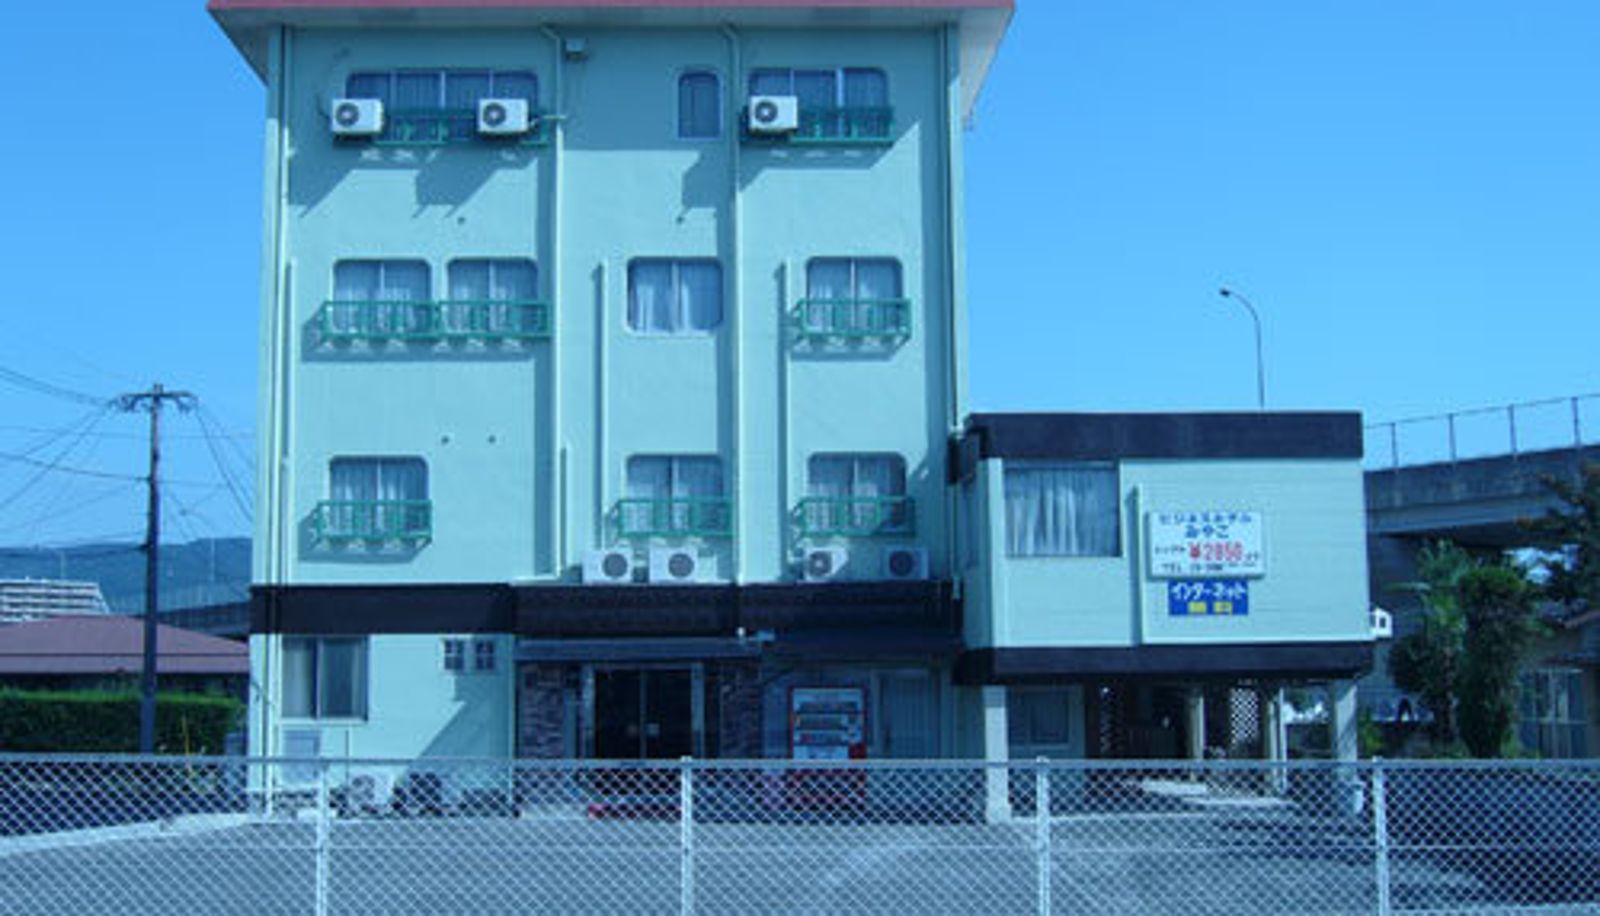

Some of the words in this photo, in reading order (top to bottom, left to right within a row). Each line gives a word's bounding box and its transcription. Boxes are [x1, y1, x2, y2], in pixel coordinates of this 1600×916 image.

[1171, 582, 1246, 600] インターネット
